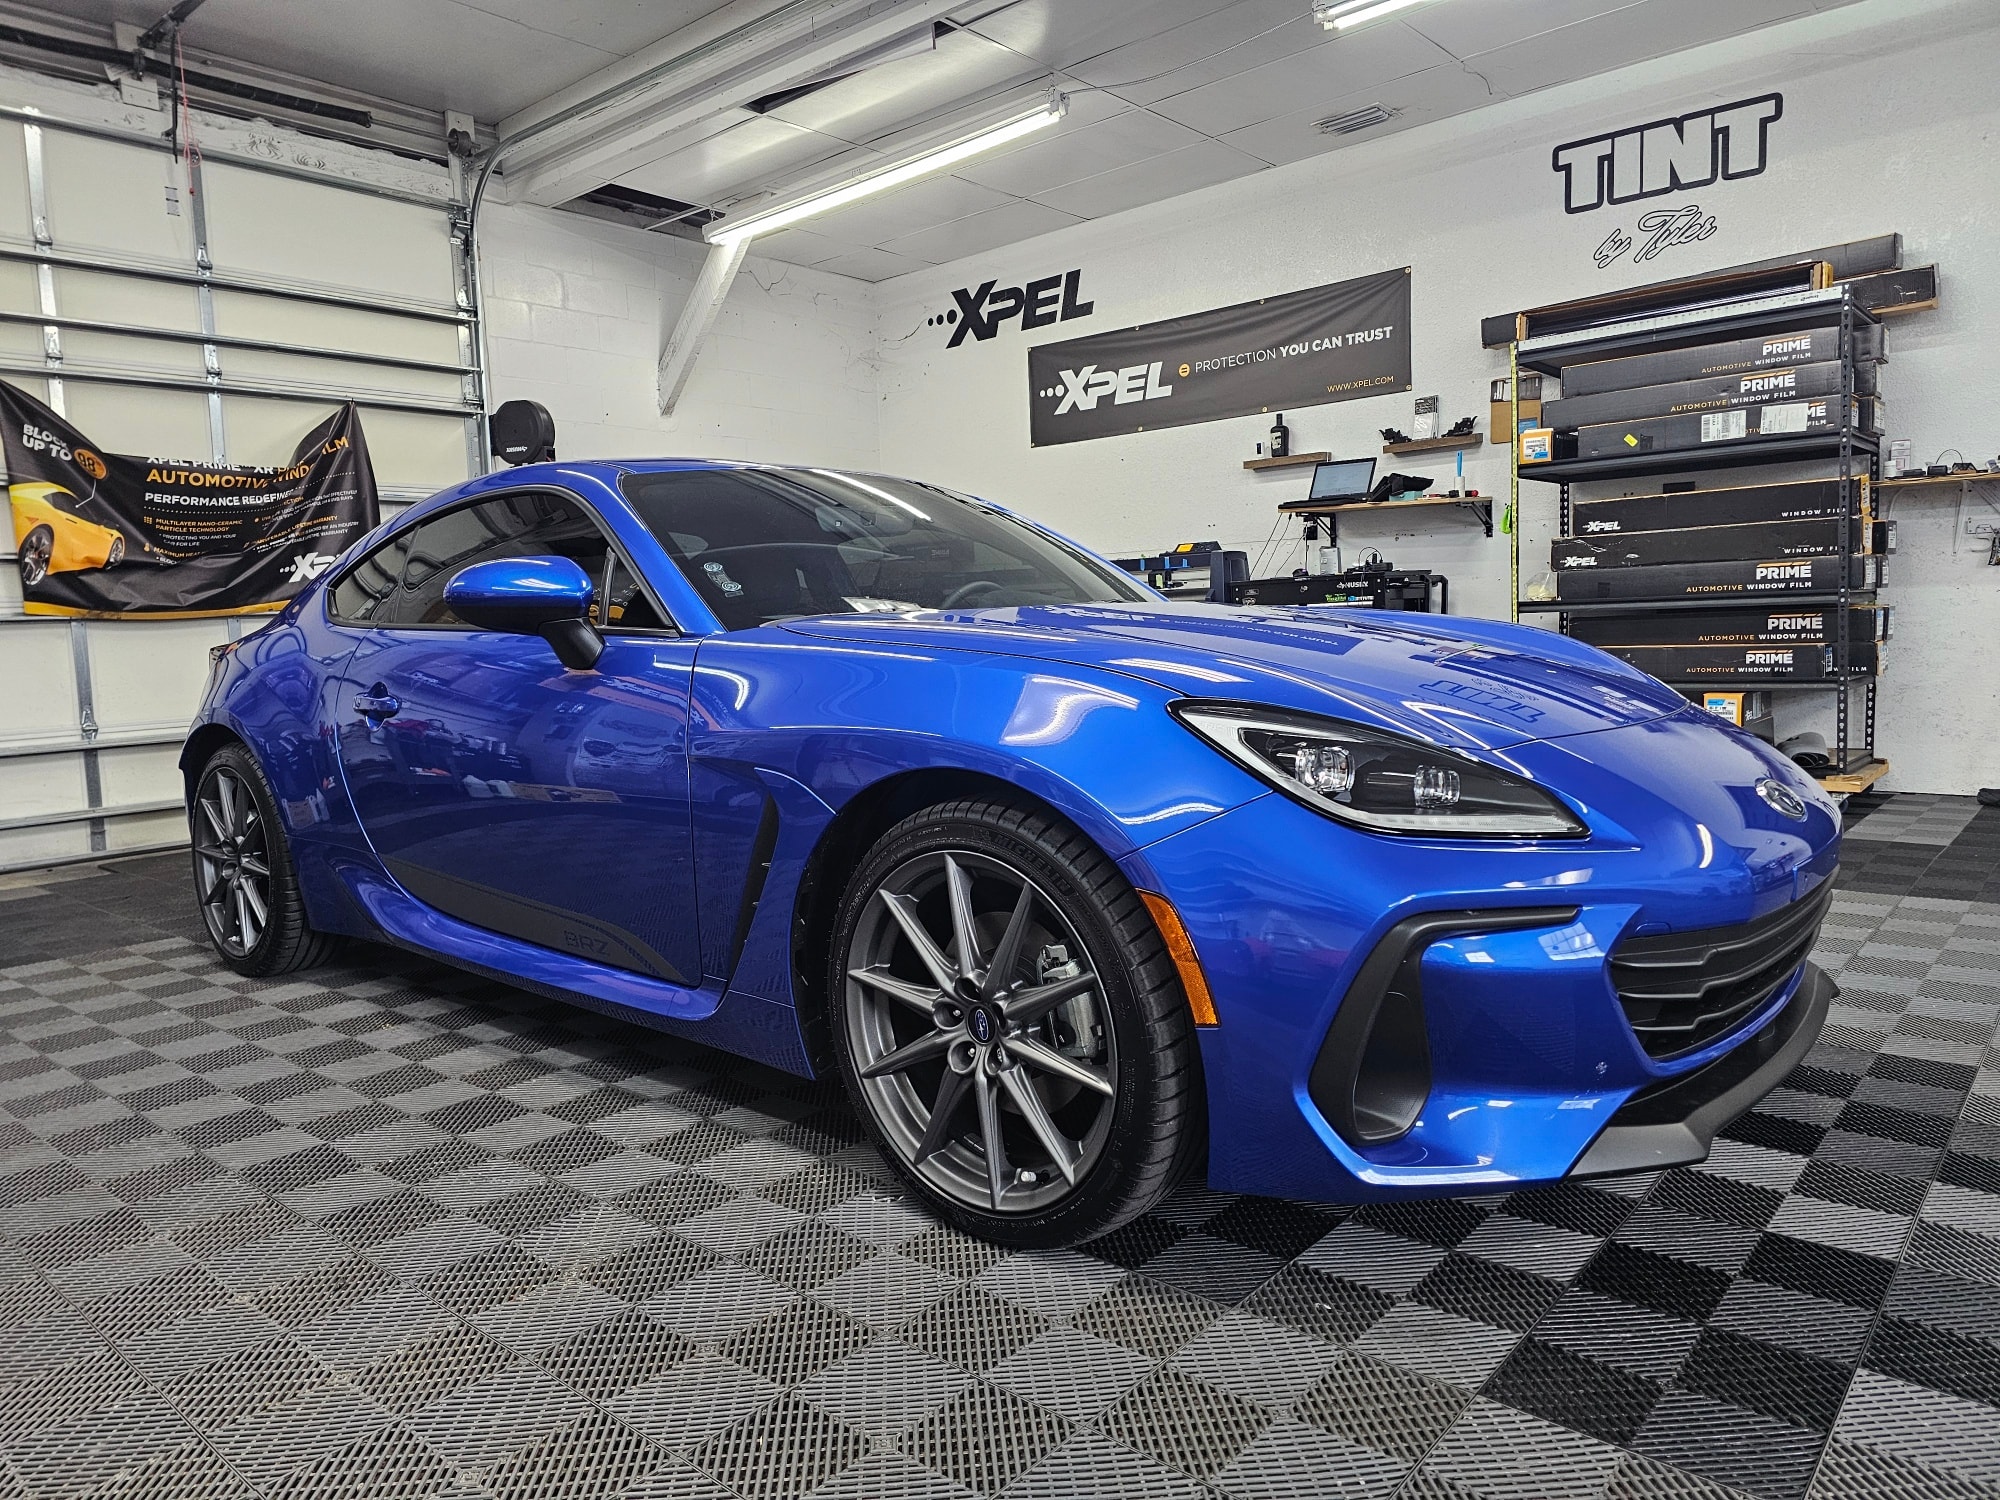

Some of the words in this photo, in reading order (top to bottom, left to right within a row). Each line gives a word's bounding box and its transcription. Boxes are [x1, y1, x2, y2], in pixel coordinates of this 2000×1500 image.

[1552, 92, 1783, 214] TINT
[1593, 228, 1632, 269] by
[1633, 204, 1718, 264] Tyler
[945, 268, 1094, 349] XPEL
[1194, 348, 1277, 374] PROTECTION
[1279, 341, 1309, 359] YOU
[1311, 335, 1343, 353] CAN
[1345, 326, 1394, 347] TRUST
[1762, 338, 1812, 356] PRIME
[1701, 361, 1752, 374] AUTOMOTIVE
[1754, 355, 1789, 366] WINDOW
[1791, 352, 1812, 360] FILM
[1053, 361, 1173, 416] XPEL
[1326, 374, 1395, 394] WWW.XPEL.COM
[1740, 373, 1796, 393] PRIME
[1670, 399, 1728, 412] AUTOMOTIVE
[1730, 393, 1771, 405] WINDOW
[1773, 390, 1796, 399] FILM
[22, 434, 46, 451] UP
[49, 443, 73, 461] TO
[144, 492, 241, 507] PERFORMANCE
[1781, 509, 1822, 517] WINDOW
[155, 518, 197, 527] MULTILAYER
[197, 519, 243, 527] NANO-CERAMIC
[155, 524, 187, 533] PARTICLE
[1585, 520, 1621, 532] XPEL
[1783, 546, 1824, 554] WINDOW
[1564, 556, 1598, 567] XPEL
[1756, 565, 1812, 580] PRIME
[1686, 584, 1743, 593] AUTOMOTIVE
[1746, 582, 1786, 590] WINDOW
[1767, 617, 1823, 630] PRIME
[1745, 653, 1793, 664] PRIME
[563, 930, 611, 957] BRZ
